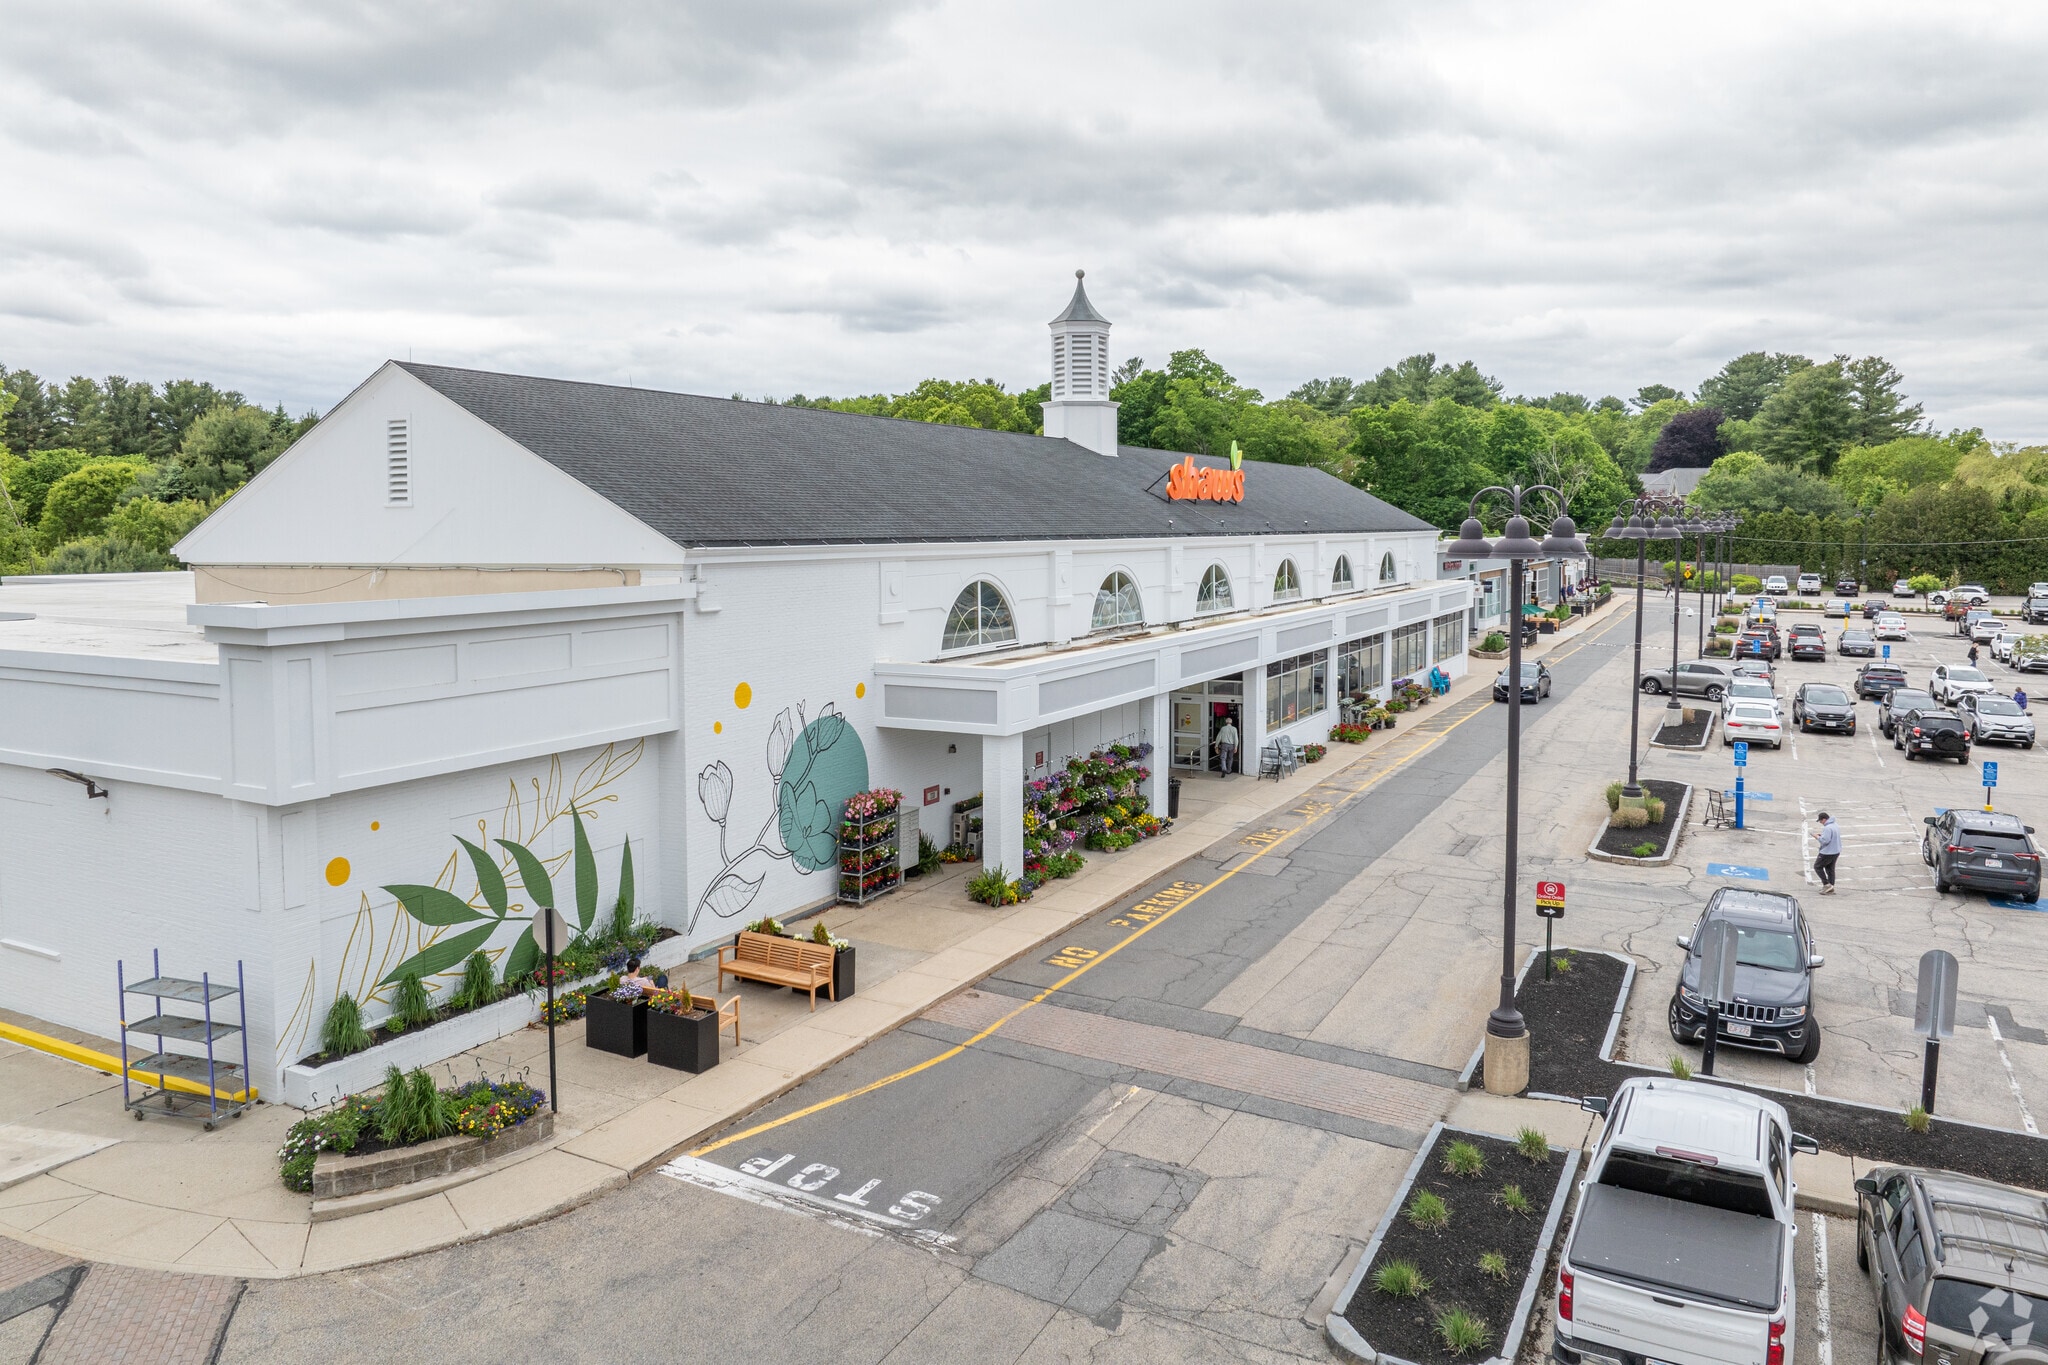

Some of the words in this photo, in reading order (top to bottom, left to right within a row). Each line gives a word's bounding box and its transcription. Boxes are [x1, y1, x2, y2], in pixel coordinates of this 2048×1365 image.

[1048, 946, 1099, 969] NO
[1106, 881, 1203, 930] PARKING
[739, 1153, 942, 1221] STOP
